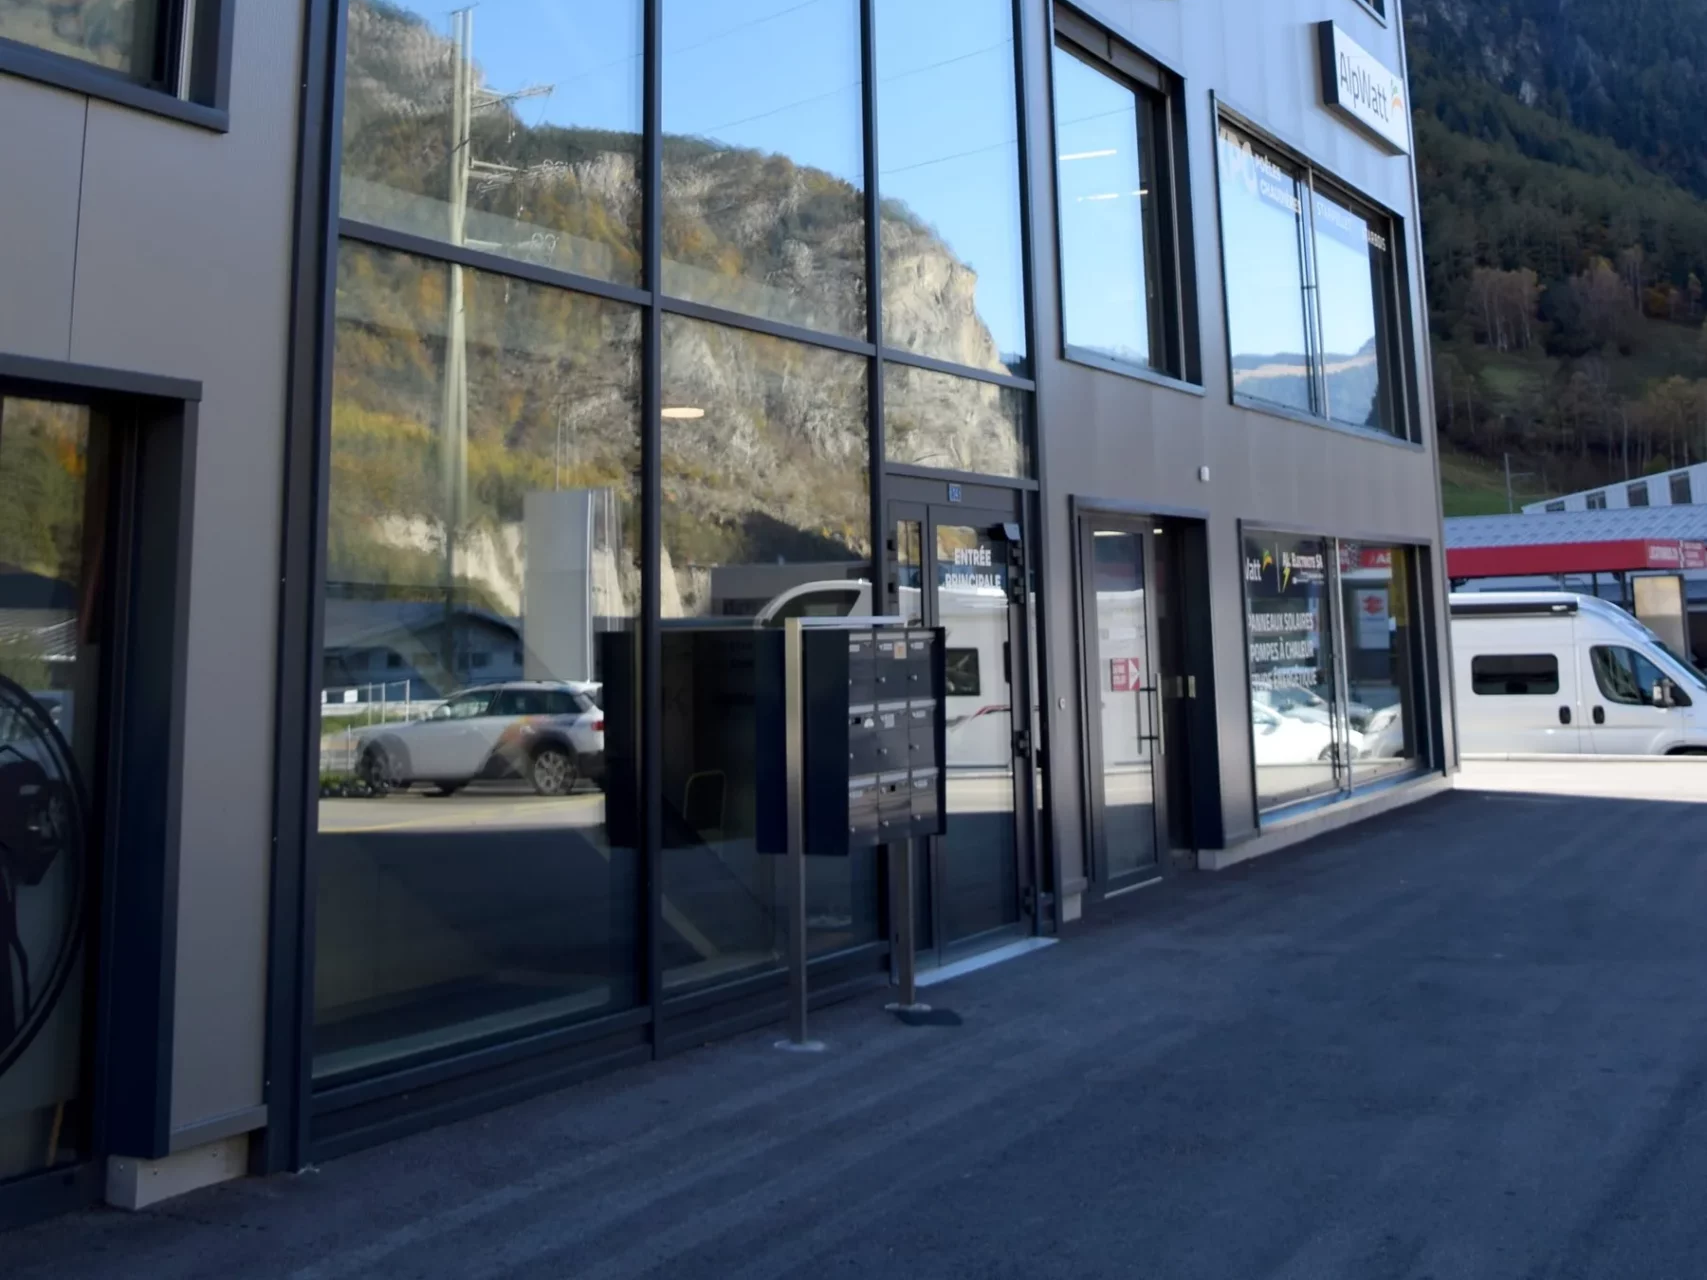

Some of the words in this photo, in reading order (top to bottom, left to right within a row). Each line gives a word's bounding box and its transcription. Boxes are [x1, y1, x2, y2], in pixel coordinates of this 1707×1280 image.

[1339, 50, 1389, 123] AlpWatt
[955, 545, 992, 567] ENTRÉE
[945, 572, 1002, 589] PRINCIPALE
[1284, 612, 1313, 631] SOLAIRES
[1250, 642, 1279, 663] POMPES
[1285, 640, 1314, 659] CHALEUR
